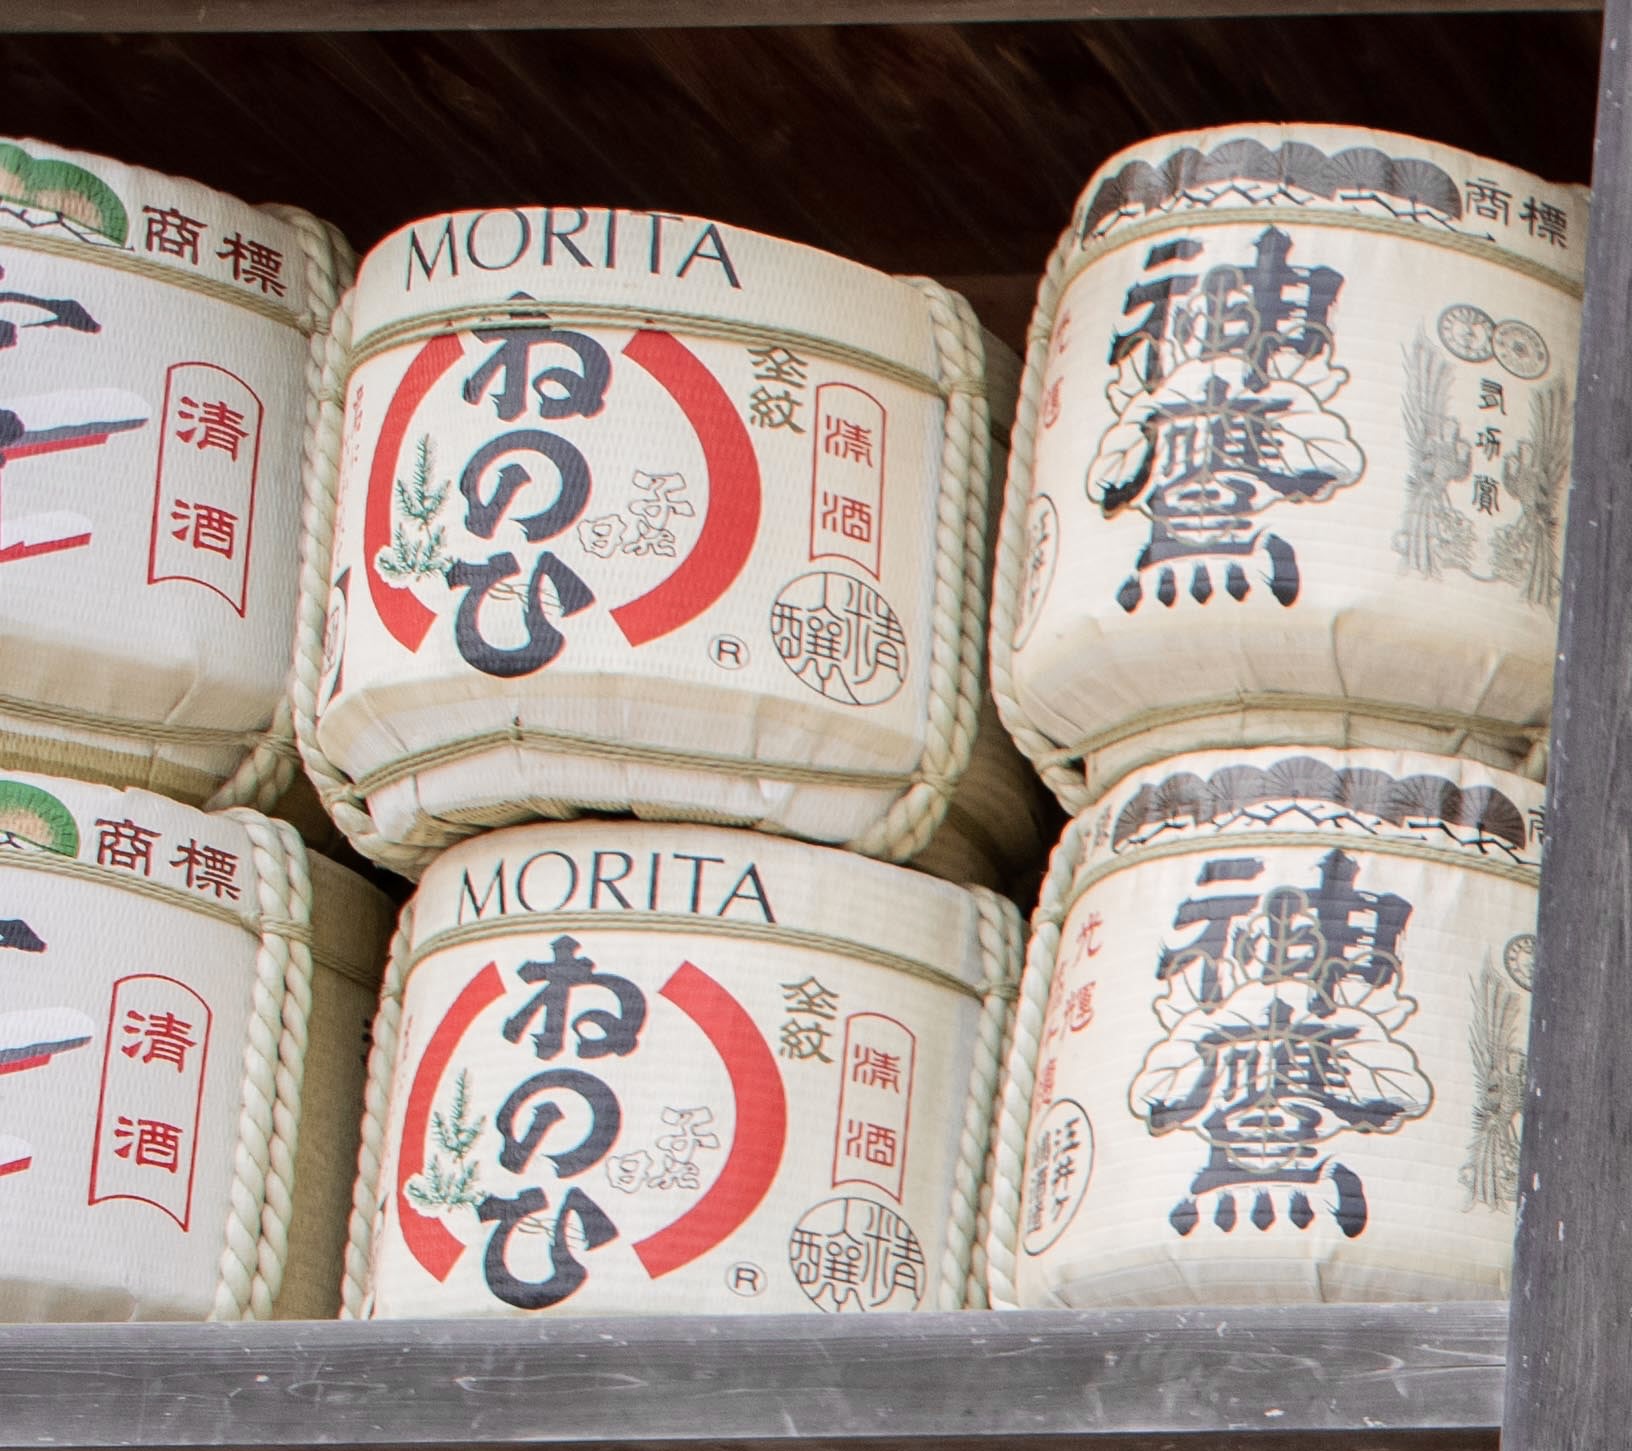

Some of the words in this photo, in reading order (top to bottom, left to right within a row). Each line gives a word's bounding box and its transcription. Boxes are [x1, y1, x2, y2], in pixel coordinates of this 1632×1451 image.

[143, 207, 287, 295] 商標
[404, 209, 741, 289] MORITA
[1464, 178, 1569, 249] 商標
[170, 395, 246, 558] 清酒
[445, 292, 611, 678] ねのひ
[95, 817, 241, 900] 商標
[457, 850, 776, 925] MORITA
[113, 1011, 197, 1173] 清酒
[477, 936, 647, 1308] ねのひ
